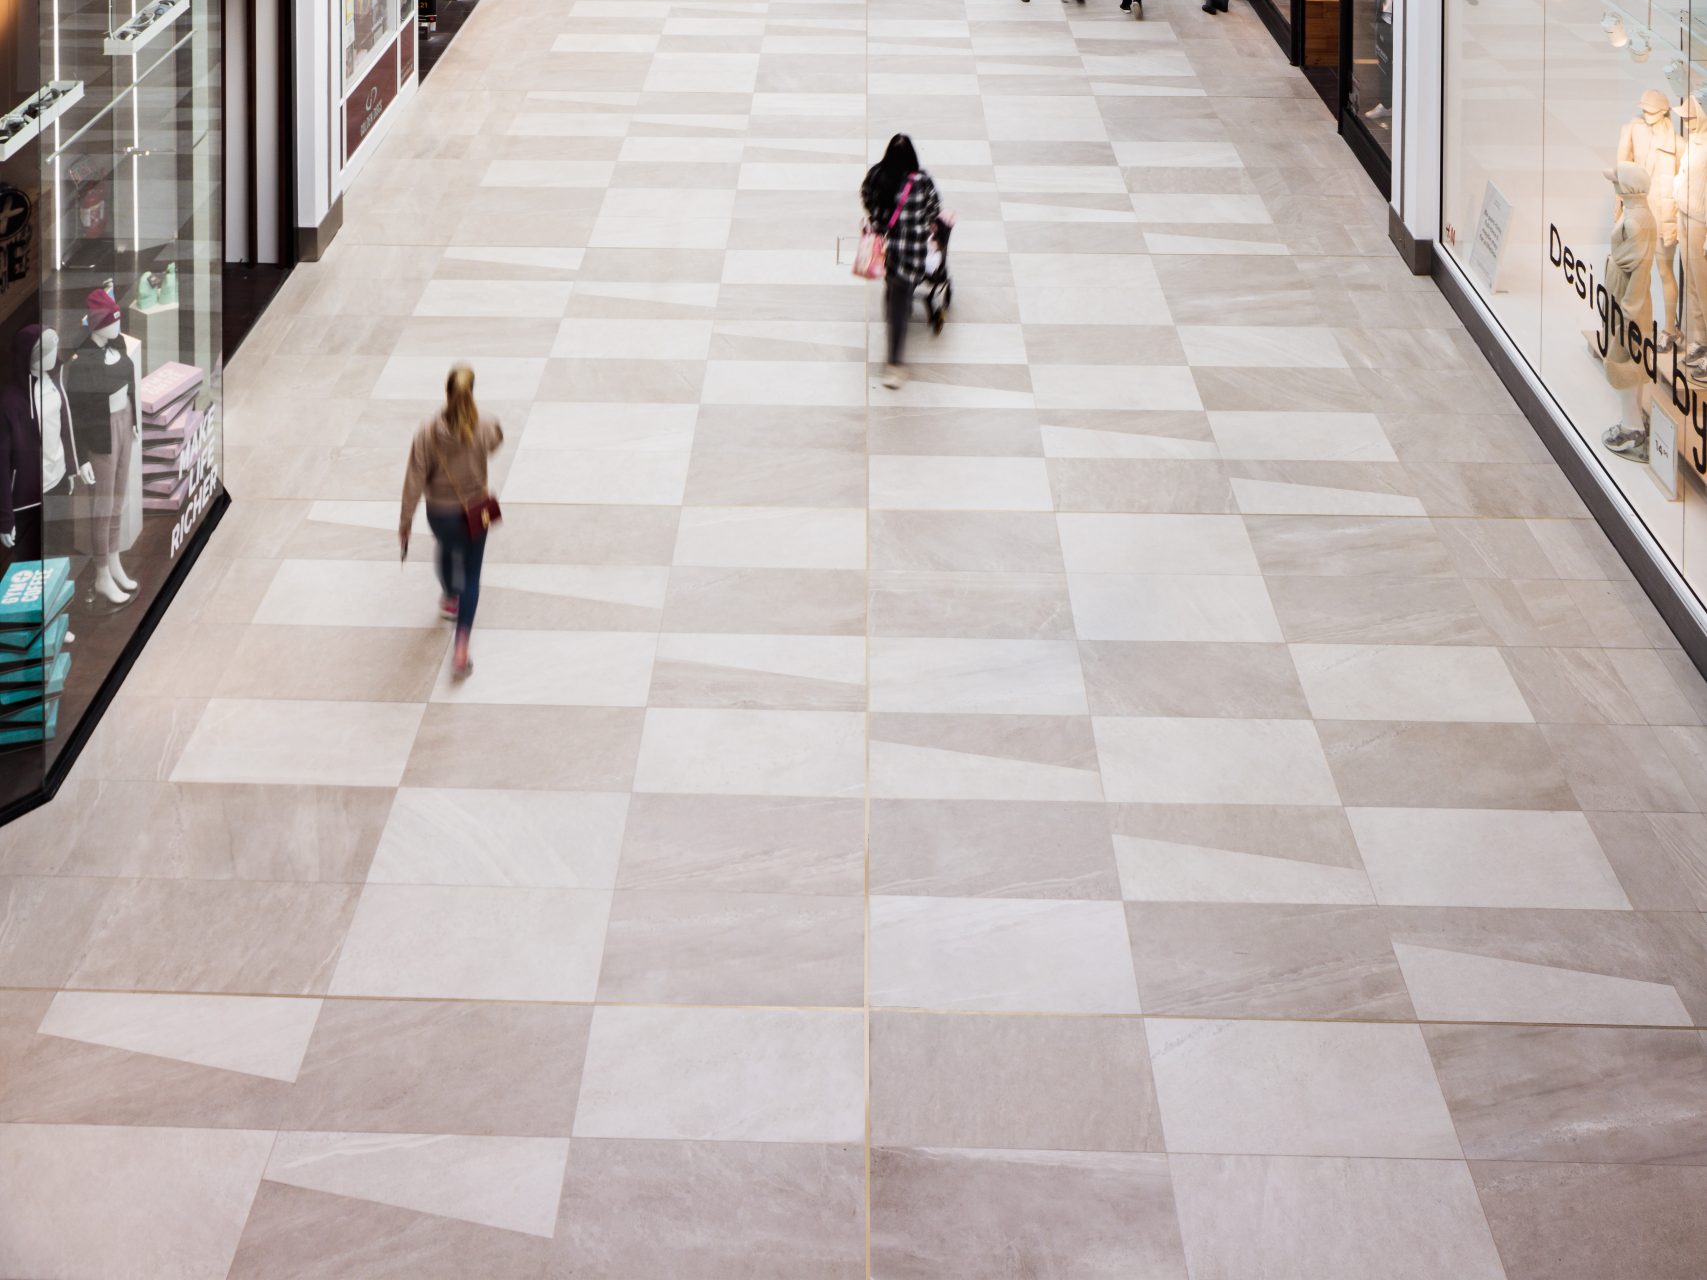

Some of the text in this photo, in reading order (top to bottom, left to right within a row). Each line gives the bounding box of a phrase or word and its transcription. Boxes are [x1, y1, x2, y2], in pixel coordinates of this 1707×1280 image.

[1549, 222, 1707, 475] Designed by
[178, 403, 216, 480] MAKE
[188, 437, 215, 498] LIFE
[170, 463, 219, 559] RICHER
